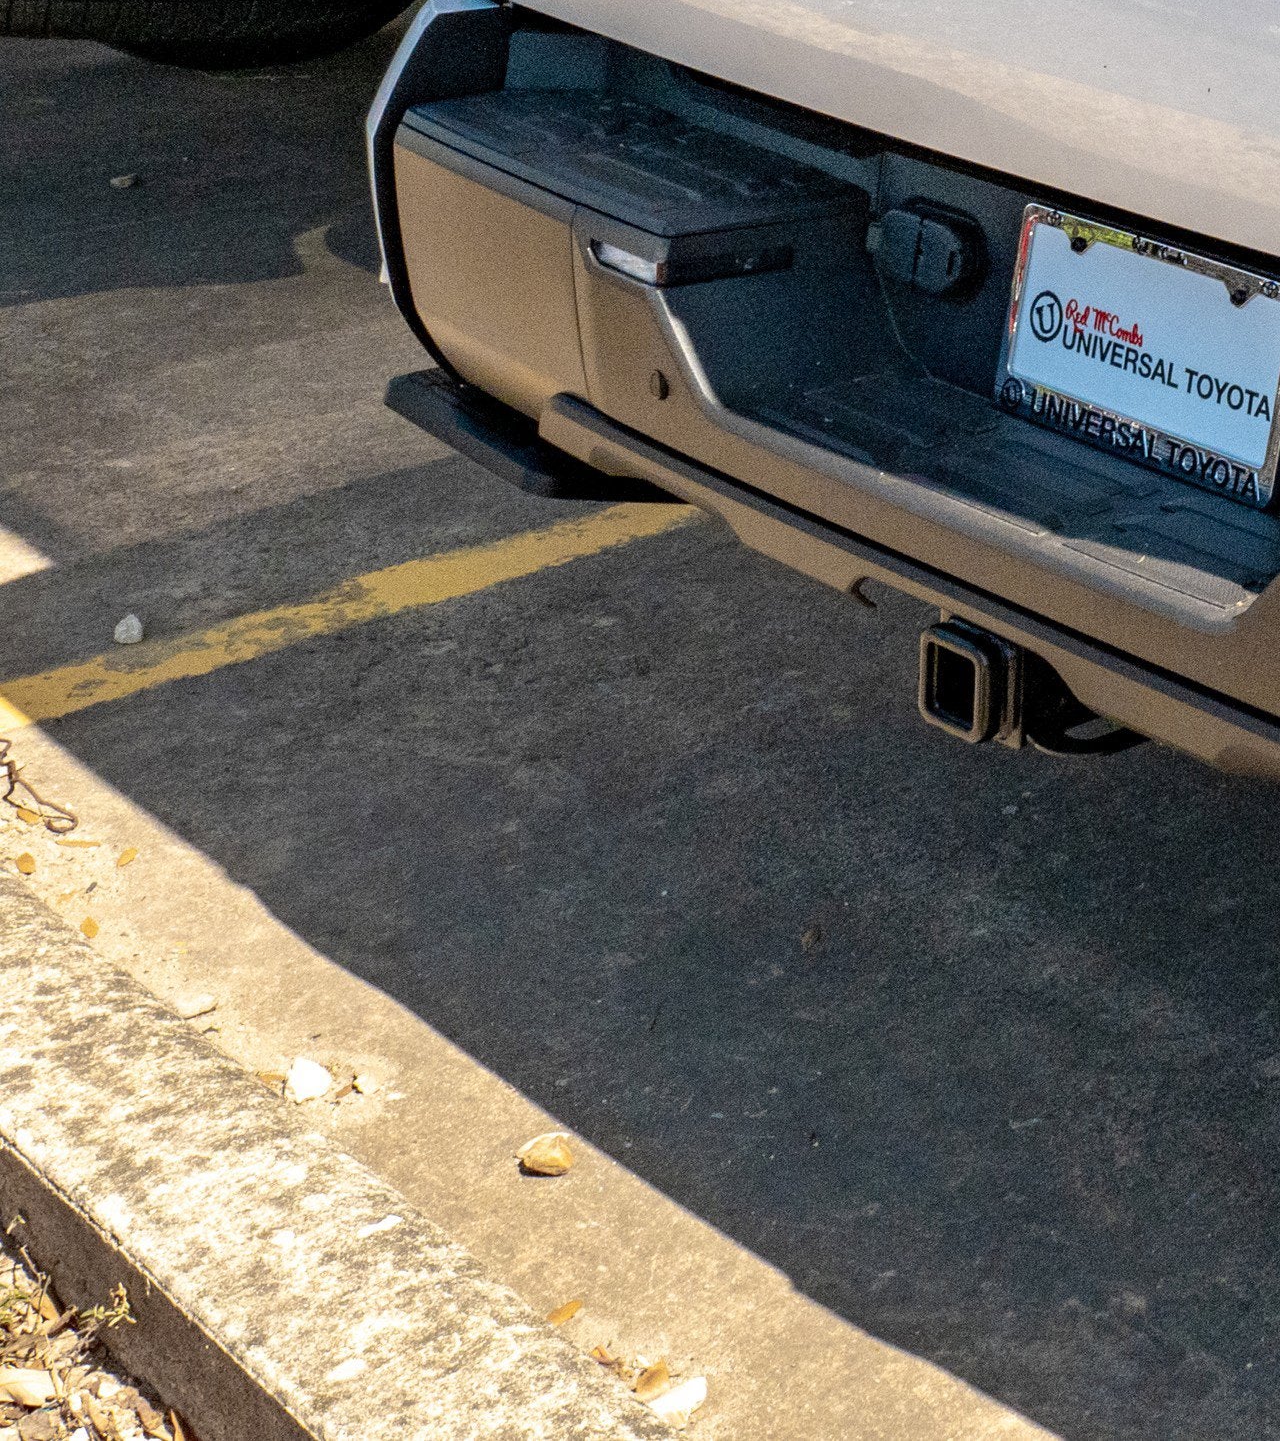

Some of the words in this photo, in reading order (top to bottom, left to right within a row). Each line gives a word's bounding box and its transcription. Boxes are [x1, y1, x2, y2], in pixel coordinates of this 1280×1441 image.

[1066, 299, 1090, 334] Red
[1062, 324, 1179, 389] UNIVERSAL
[1184, 367, 1270, 422] TOYOTA
[1030, 386, 1161, 461] UNIVERSAL
[1166, 438, 1260, 502] TOYOTA
